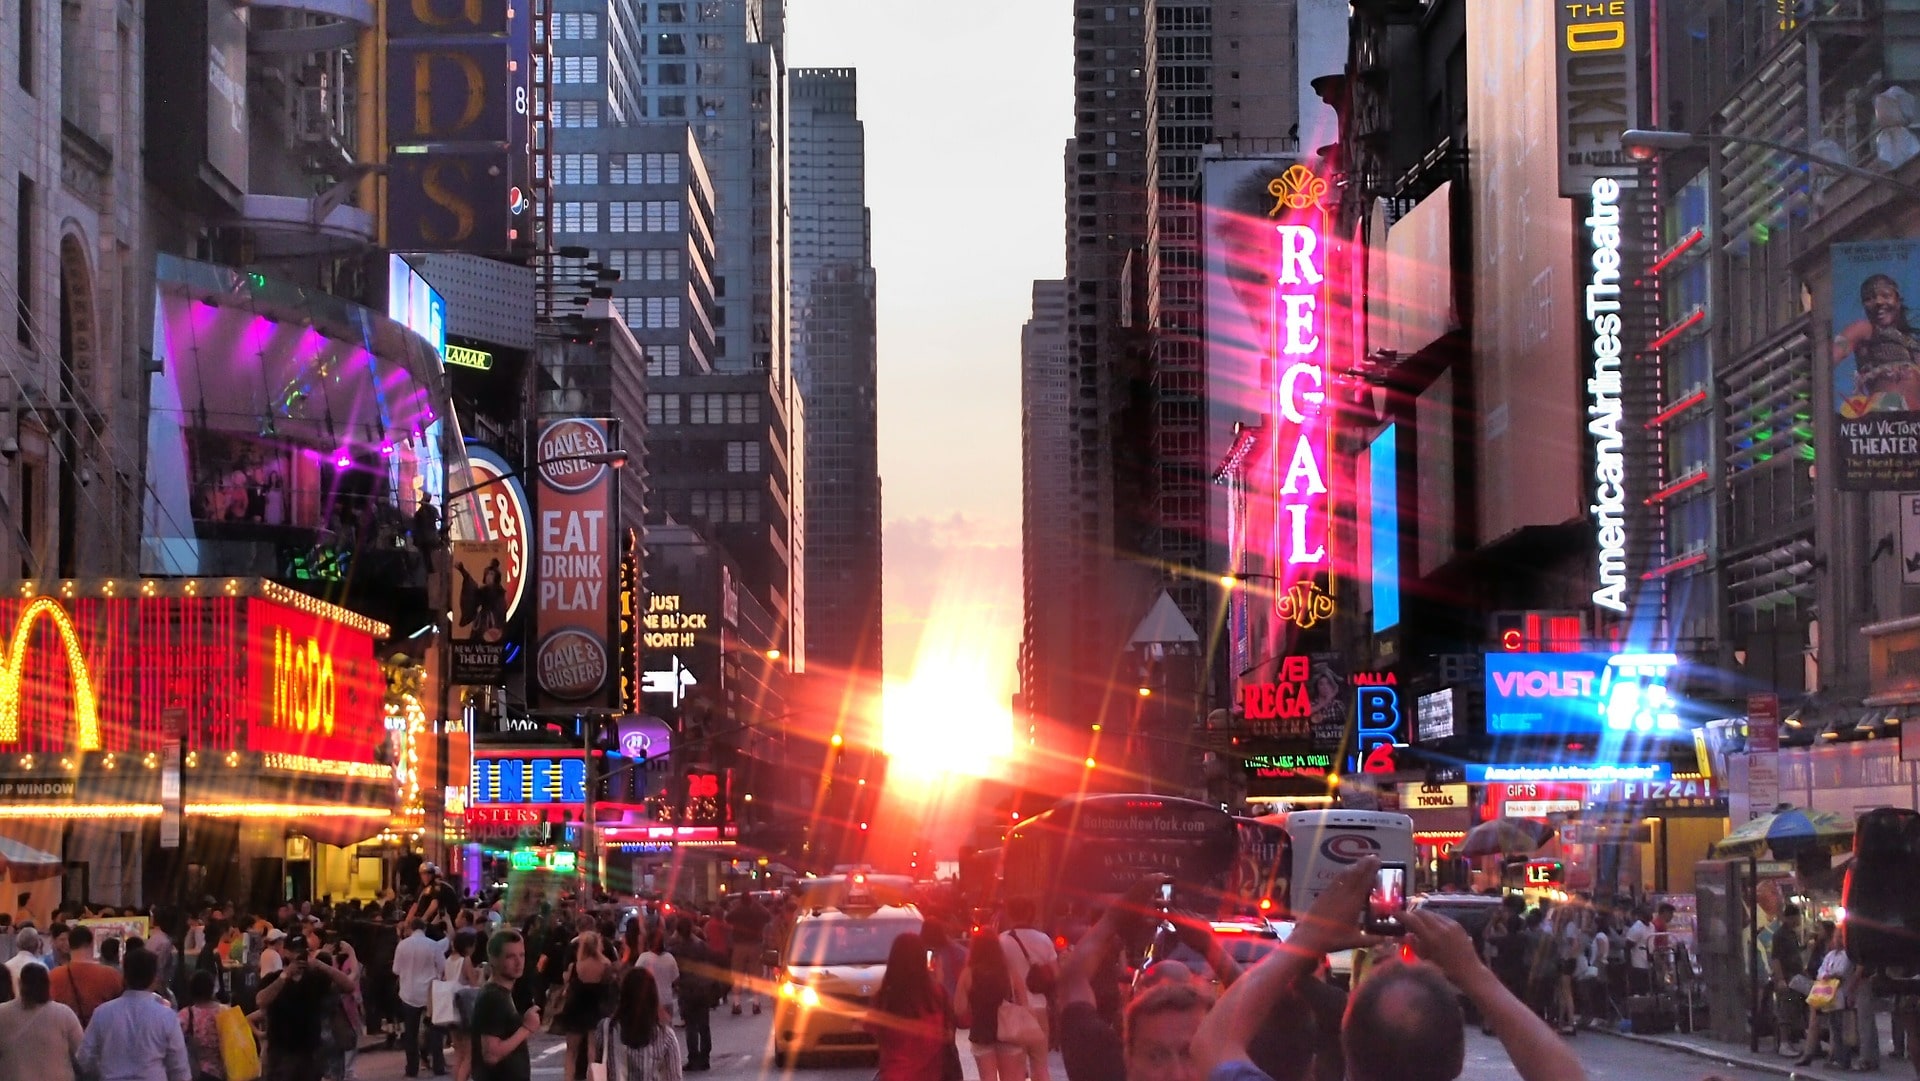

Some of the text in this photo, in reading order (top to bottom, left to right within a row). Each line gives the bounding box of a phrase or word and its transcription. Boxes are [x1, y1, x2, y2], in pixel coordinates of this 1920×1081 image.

[1567, 3, 1625, 17] THE
[447, 346, 486, 367] LAMAR
[1276, 224, 1327, 564] REGAL
[1586, 177, 1627, 612] AmericanAirlinesTheatre
[1840, 420, 1920, 437] NEW VICTORY
[544, 431, 600, 460] DAVE &
[1850, 437, 1917, 455] THEATER
[496, 493, 518, 538] &
[543, 510, 603, 552] EAT
[542, 555, 601, 578] DRINK
[541, 581, 602, 610] PLAY
[460, 654, 499, 665] THEATER
[544, 643, 599, 671] DAVE &
[546, 661, 602, 688] BUSTER'S
[1492, 670, 1595, 698] VIOLET
[1244, 681, 1312, 719] REGA
[17, 783, 75, 796] WINDOW
[475, 759, 586, 804] INER
[1507, 784, 1537, 797] GIFTS
[1417, 795, 1454, 806] THOMAS
